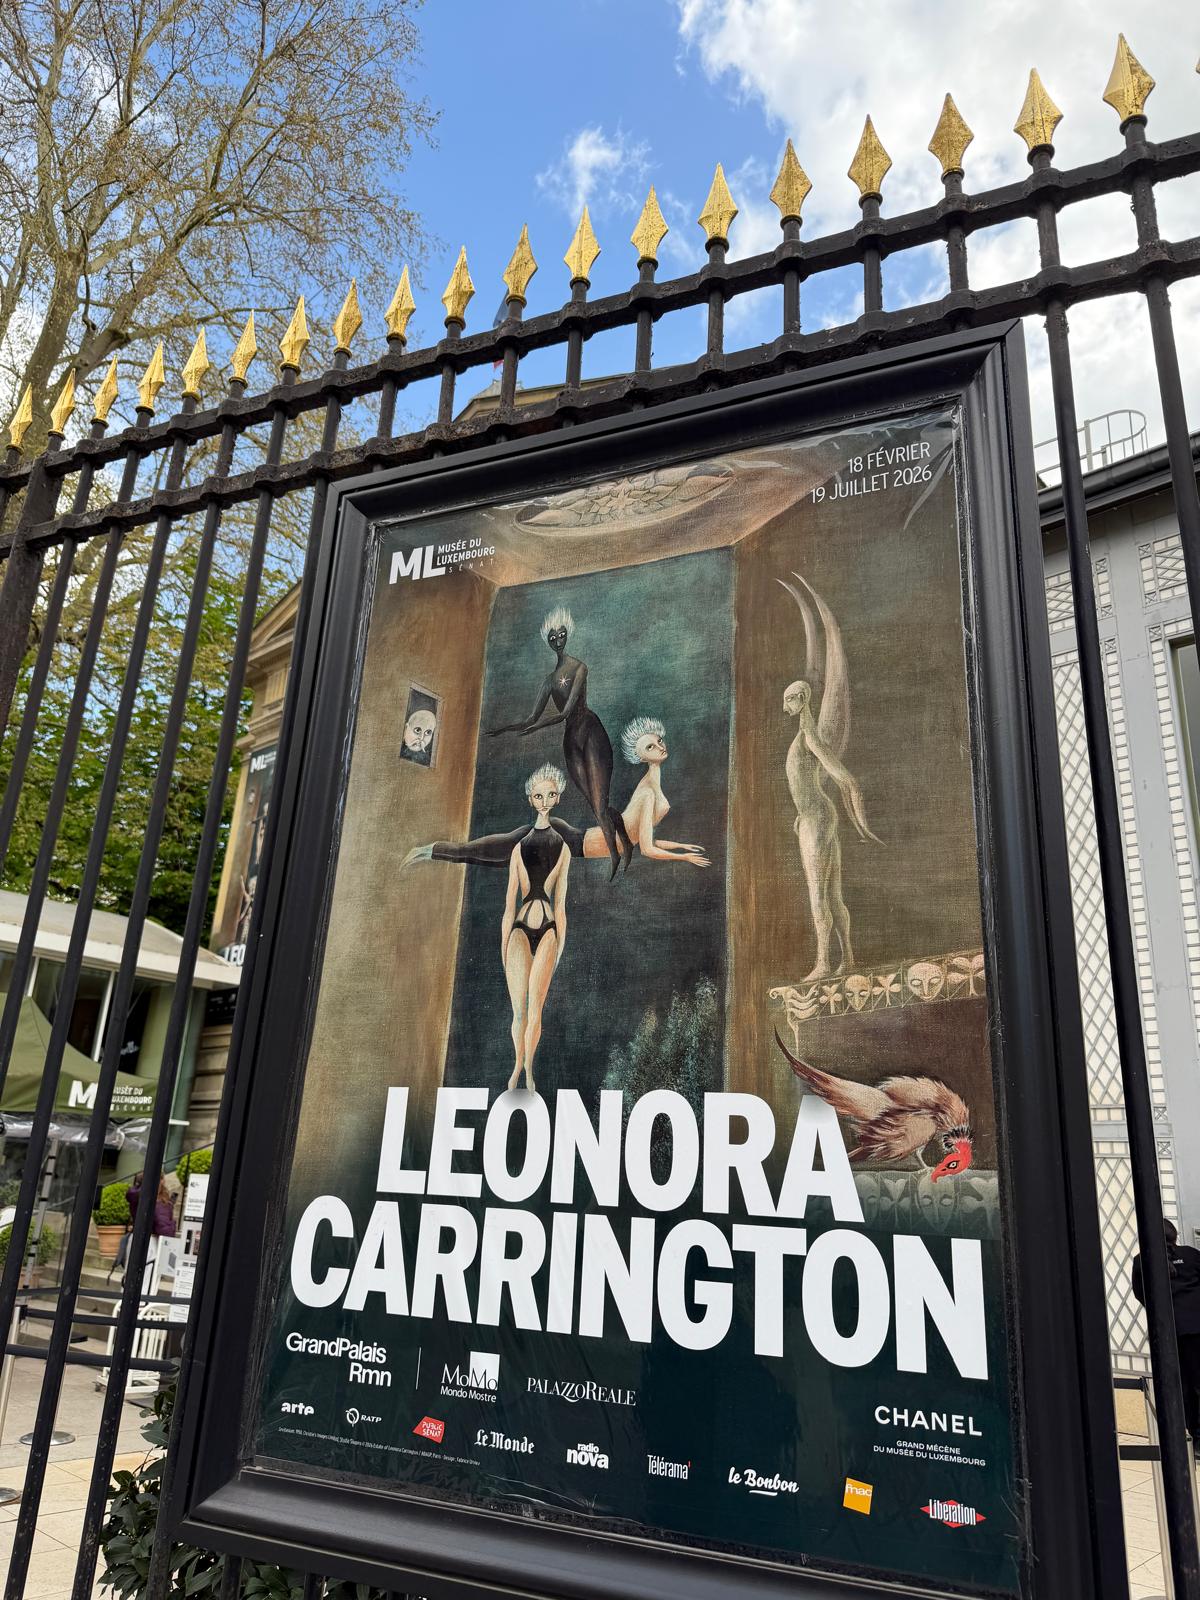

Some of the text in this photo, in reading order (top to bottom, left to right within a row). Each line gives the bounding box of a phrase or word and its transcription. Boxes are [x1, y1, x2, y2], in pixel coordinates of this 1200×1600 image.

[848, 441, 931, 474] 18 FÉVRIER
[810, 464, 932, 503] 19 JUILLET 2026
[436, 546, 495, 566] LUXEMBOURG
[438, 538, 482, 554] MUSÉE DU
[389, 545, 446, 585] ML
[111, 1095, 152, 1104] UXEMBOURG
[376, 1086, 864, 1223] LEONORA
[290, 1195, 989, 1381] CARRINGTON
[349, 1362, 392, 1387] Rmn
[441, 1363, 498, 1391] MoMo
[440, 1386, 497, 1403] Mondo Mostre
[281, 1402, 315, 1415] arte
[361, 1415, 382, 1423] RATP
[874, 1405, 983, 1437] CHANEL
[473, 1429, 535, 1454] Le Monde
[577, 1442, 600, 1452] radio
[896, 1440, 961, 1455] GRAND MÉCÈNE
[566, 1448, 609, 1469] nova
[873, 1445, 986, 1467] DU MUSÉE DU LUXEMBOURG
[728, 1466, 799, 1493] le Bonbon
[845, 1483, 873, 1497] fnac
[928, 1498, 977, 1526] Libération
